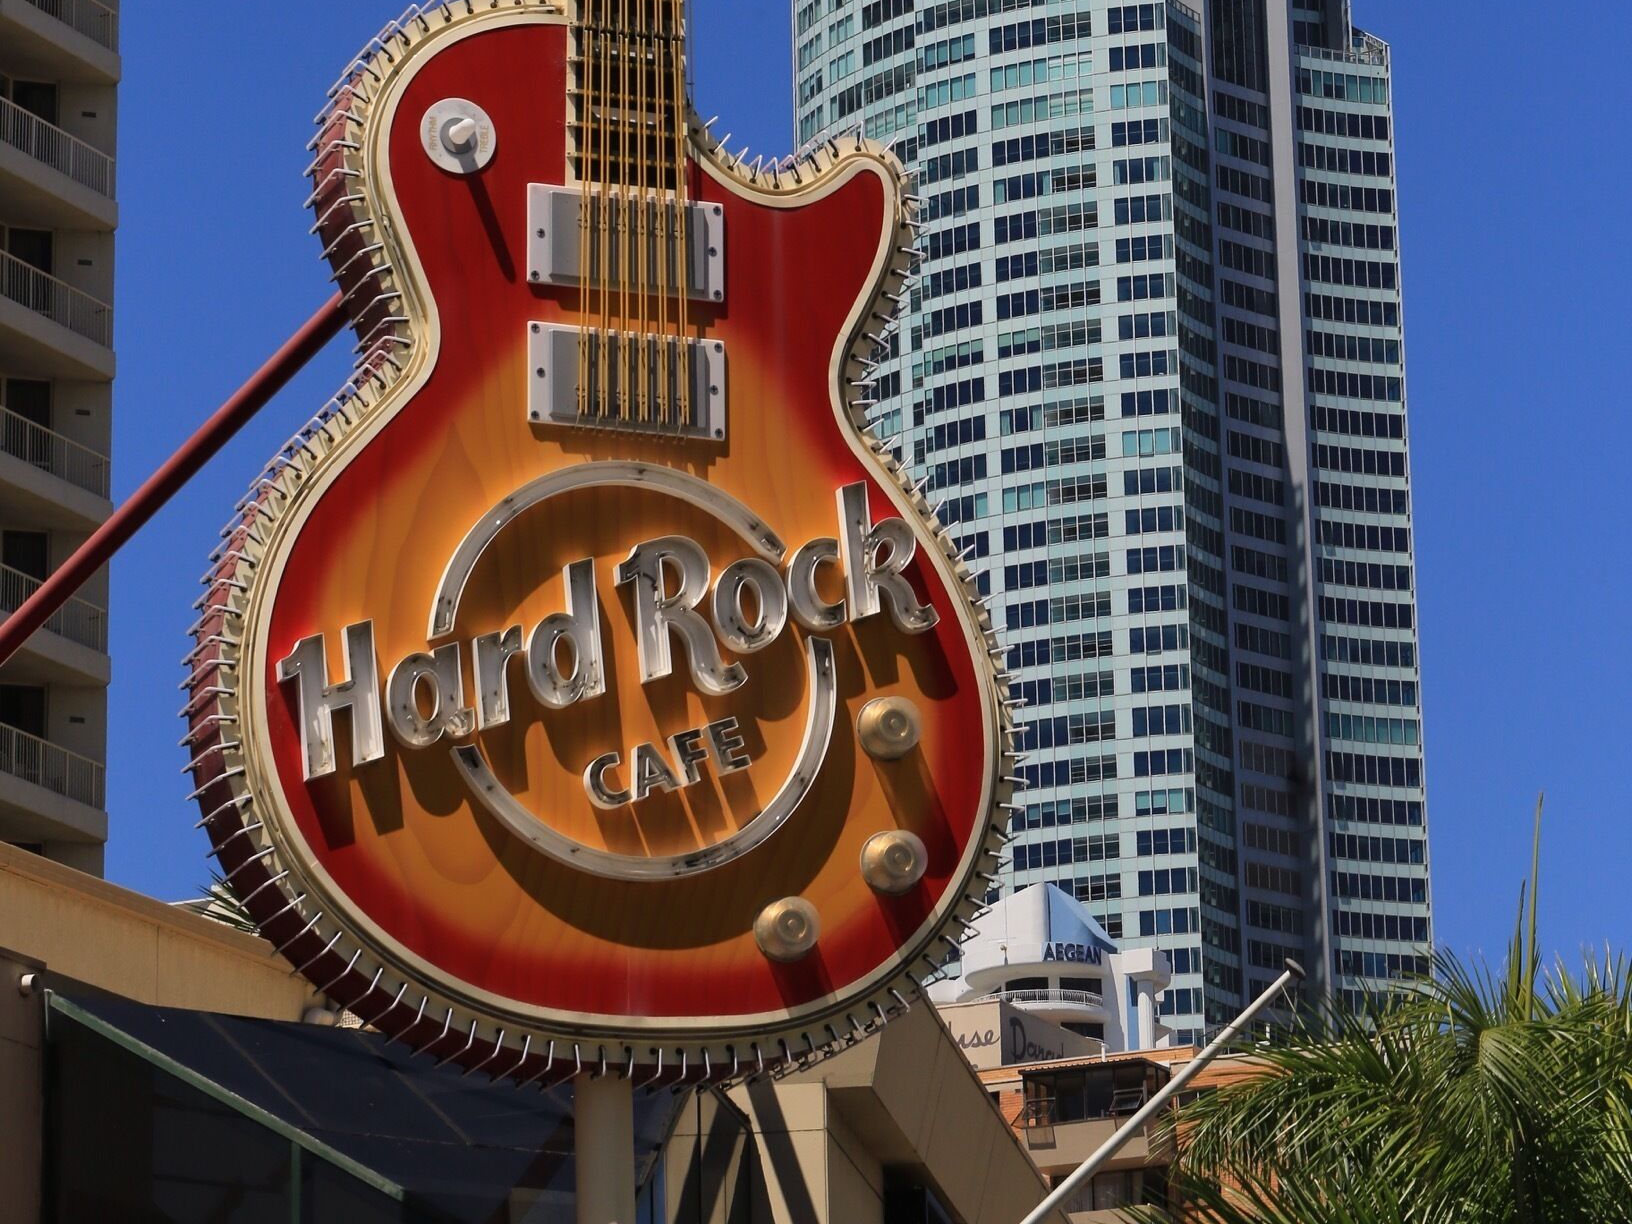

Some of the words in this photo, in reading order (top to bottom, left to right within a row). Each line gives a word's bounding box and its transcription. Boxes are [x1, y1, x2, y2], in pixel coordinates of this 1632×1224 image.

[275, 556, 606, 782] Hard
[613, 480, 940, 696] Rock
[583, 716, 752, 810] CAFE
[1042, 942, 1102, 966] AEGEAN
